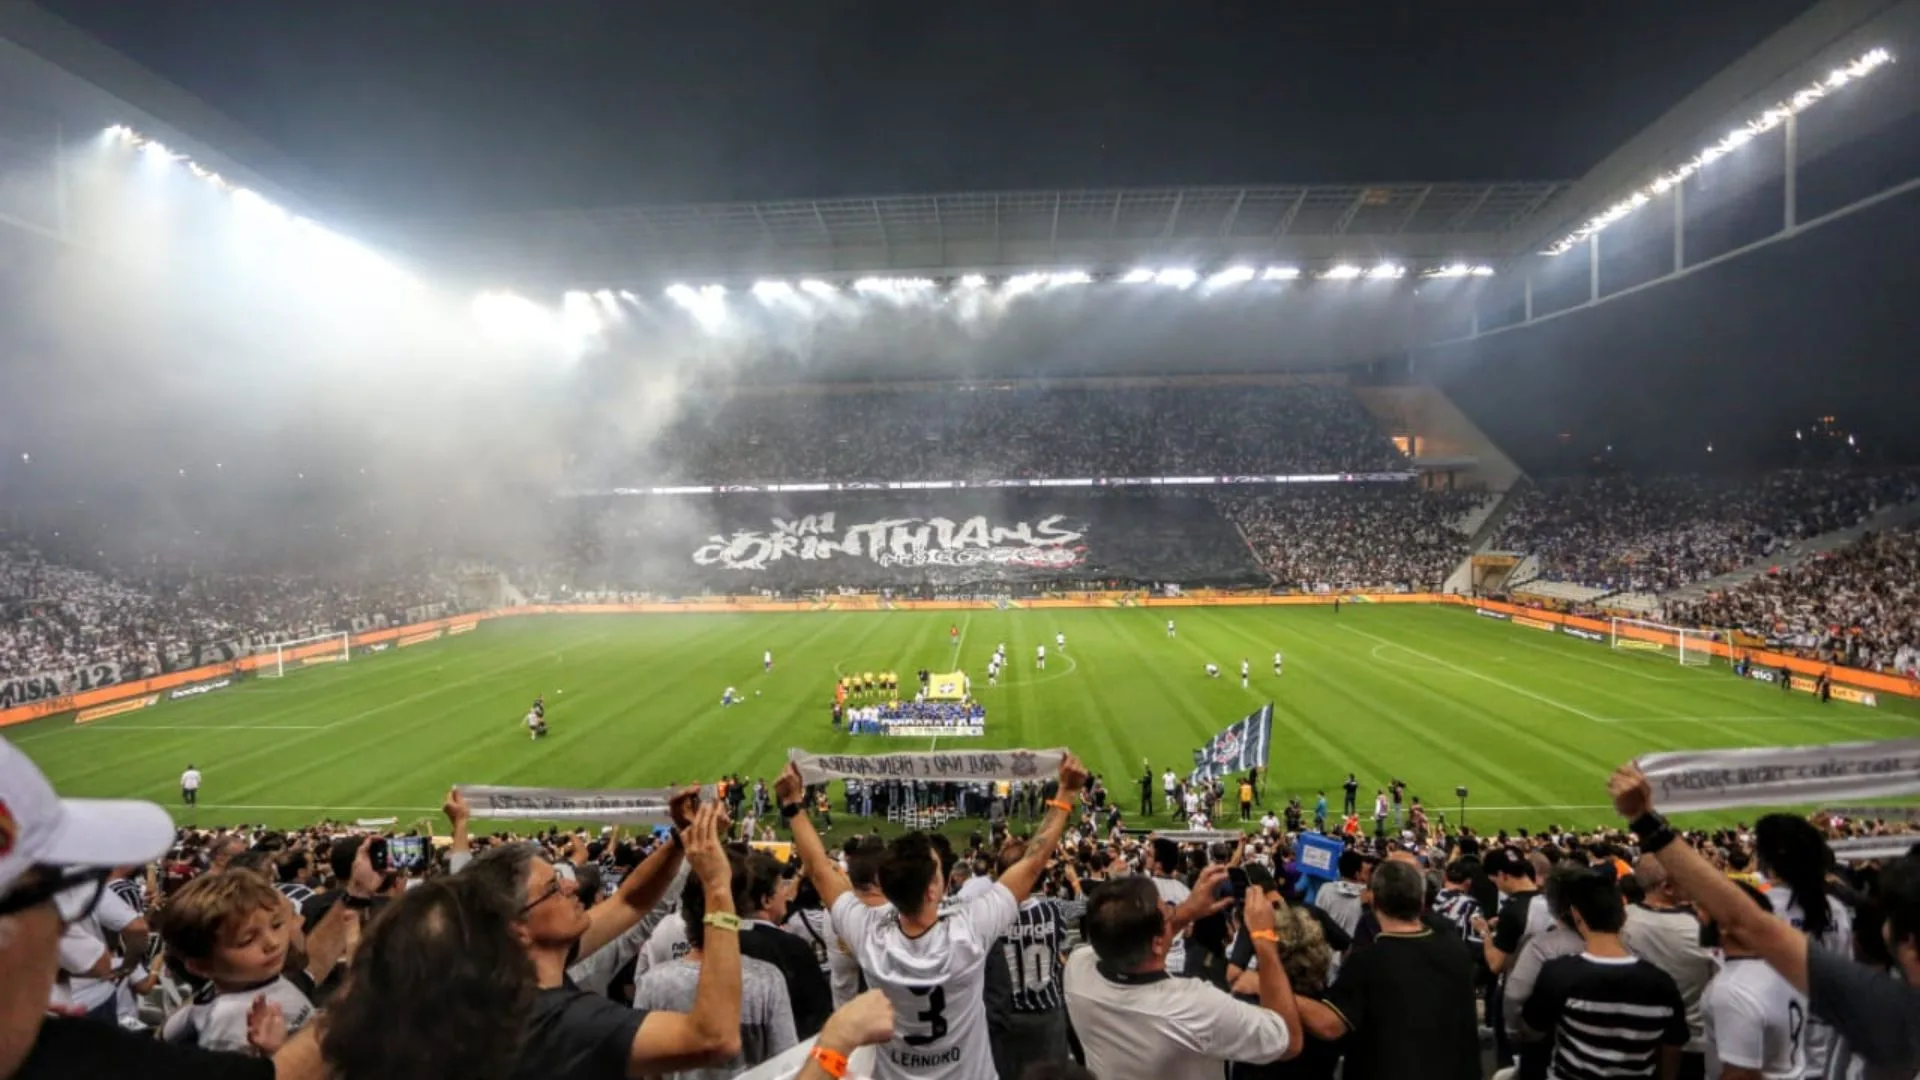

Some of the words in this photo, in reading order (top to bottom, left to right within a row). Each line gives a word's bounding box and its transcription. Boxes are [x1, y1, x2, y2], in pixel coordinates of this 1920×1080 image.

[692, 513, 1085, 569] CORINTHIANS
[771, 511, 836, 536] VAI
[78, 665, 115, 692] 12
[1002, 943, 1052, 993] 10
[903, 985, 949, 1046] 3
[891, 1046, 961, 1068] LEANDRO
